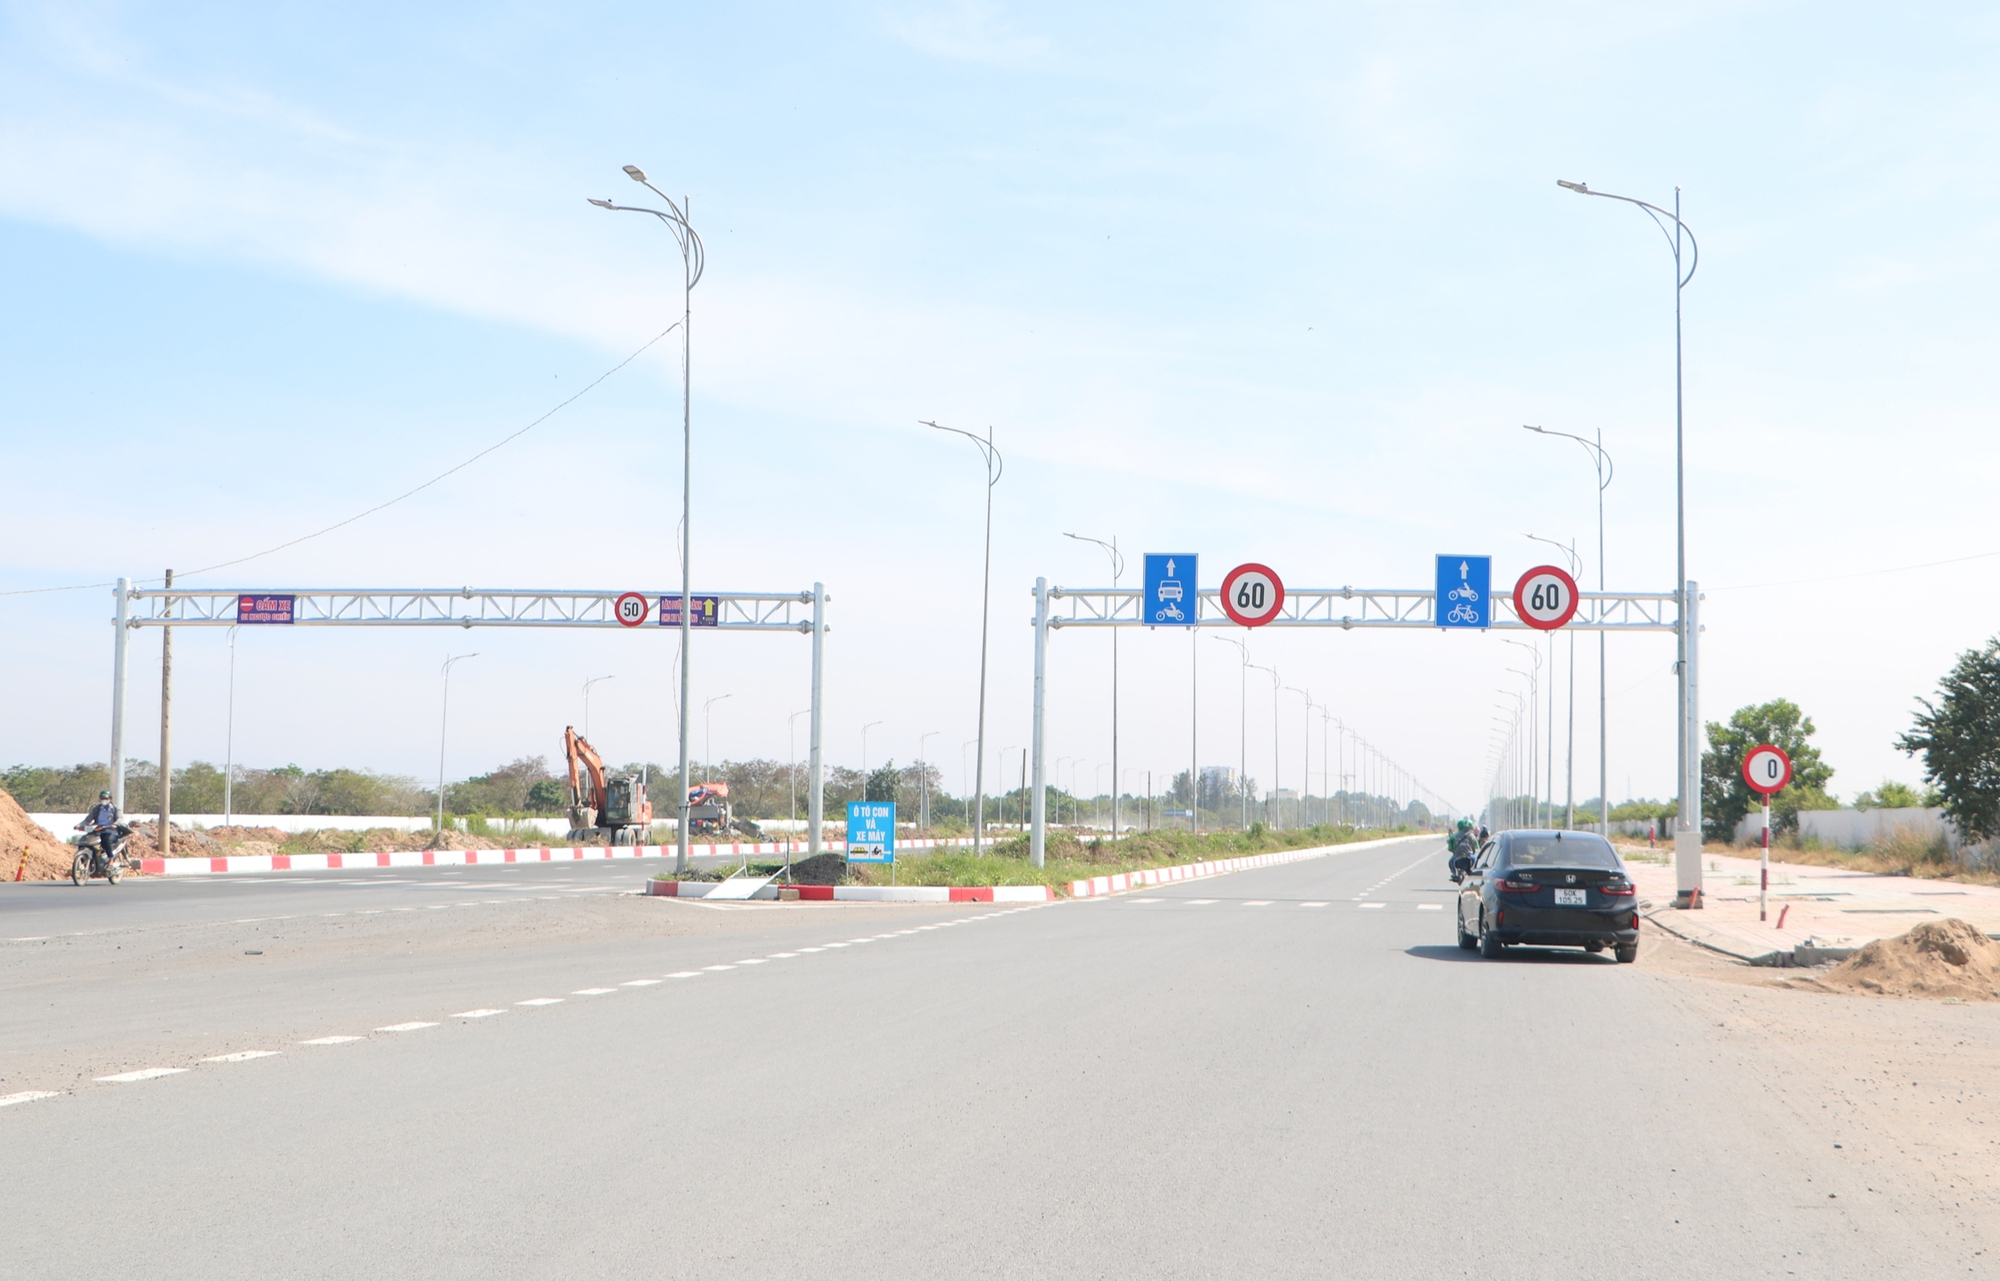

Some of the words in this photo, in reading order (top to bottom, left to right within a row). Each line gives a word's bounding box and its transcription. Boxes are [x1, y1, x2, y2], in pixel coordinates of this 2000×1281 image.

[1238, 582, 1264, 608] 60
[1532, 584, 1559, 610] 60
[256, 597, 278, 611] CẤM
[278, 600, 291, 611] XE
[624, 602, 639, 616] 50
[1768, 758, 1777, 778] 0
[854, 804, 859, 818] Ô
[861, 804, 870, 818] TÔ
[872, 807, 888, 818] CON
[866, 816, 876, 830] VÀ
[856, 831, 866, 842] XE
[868, 829, 885, 842] MÁY
